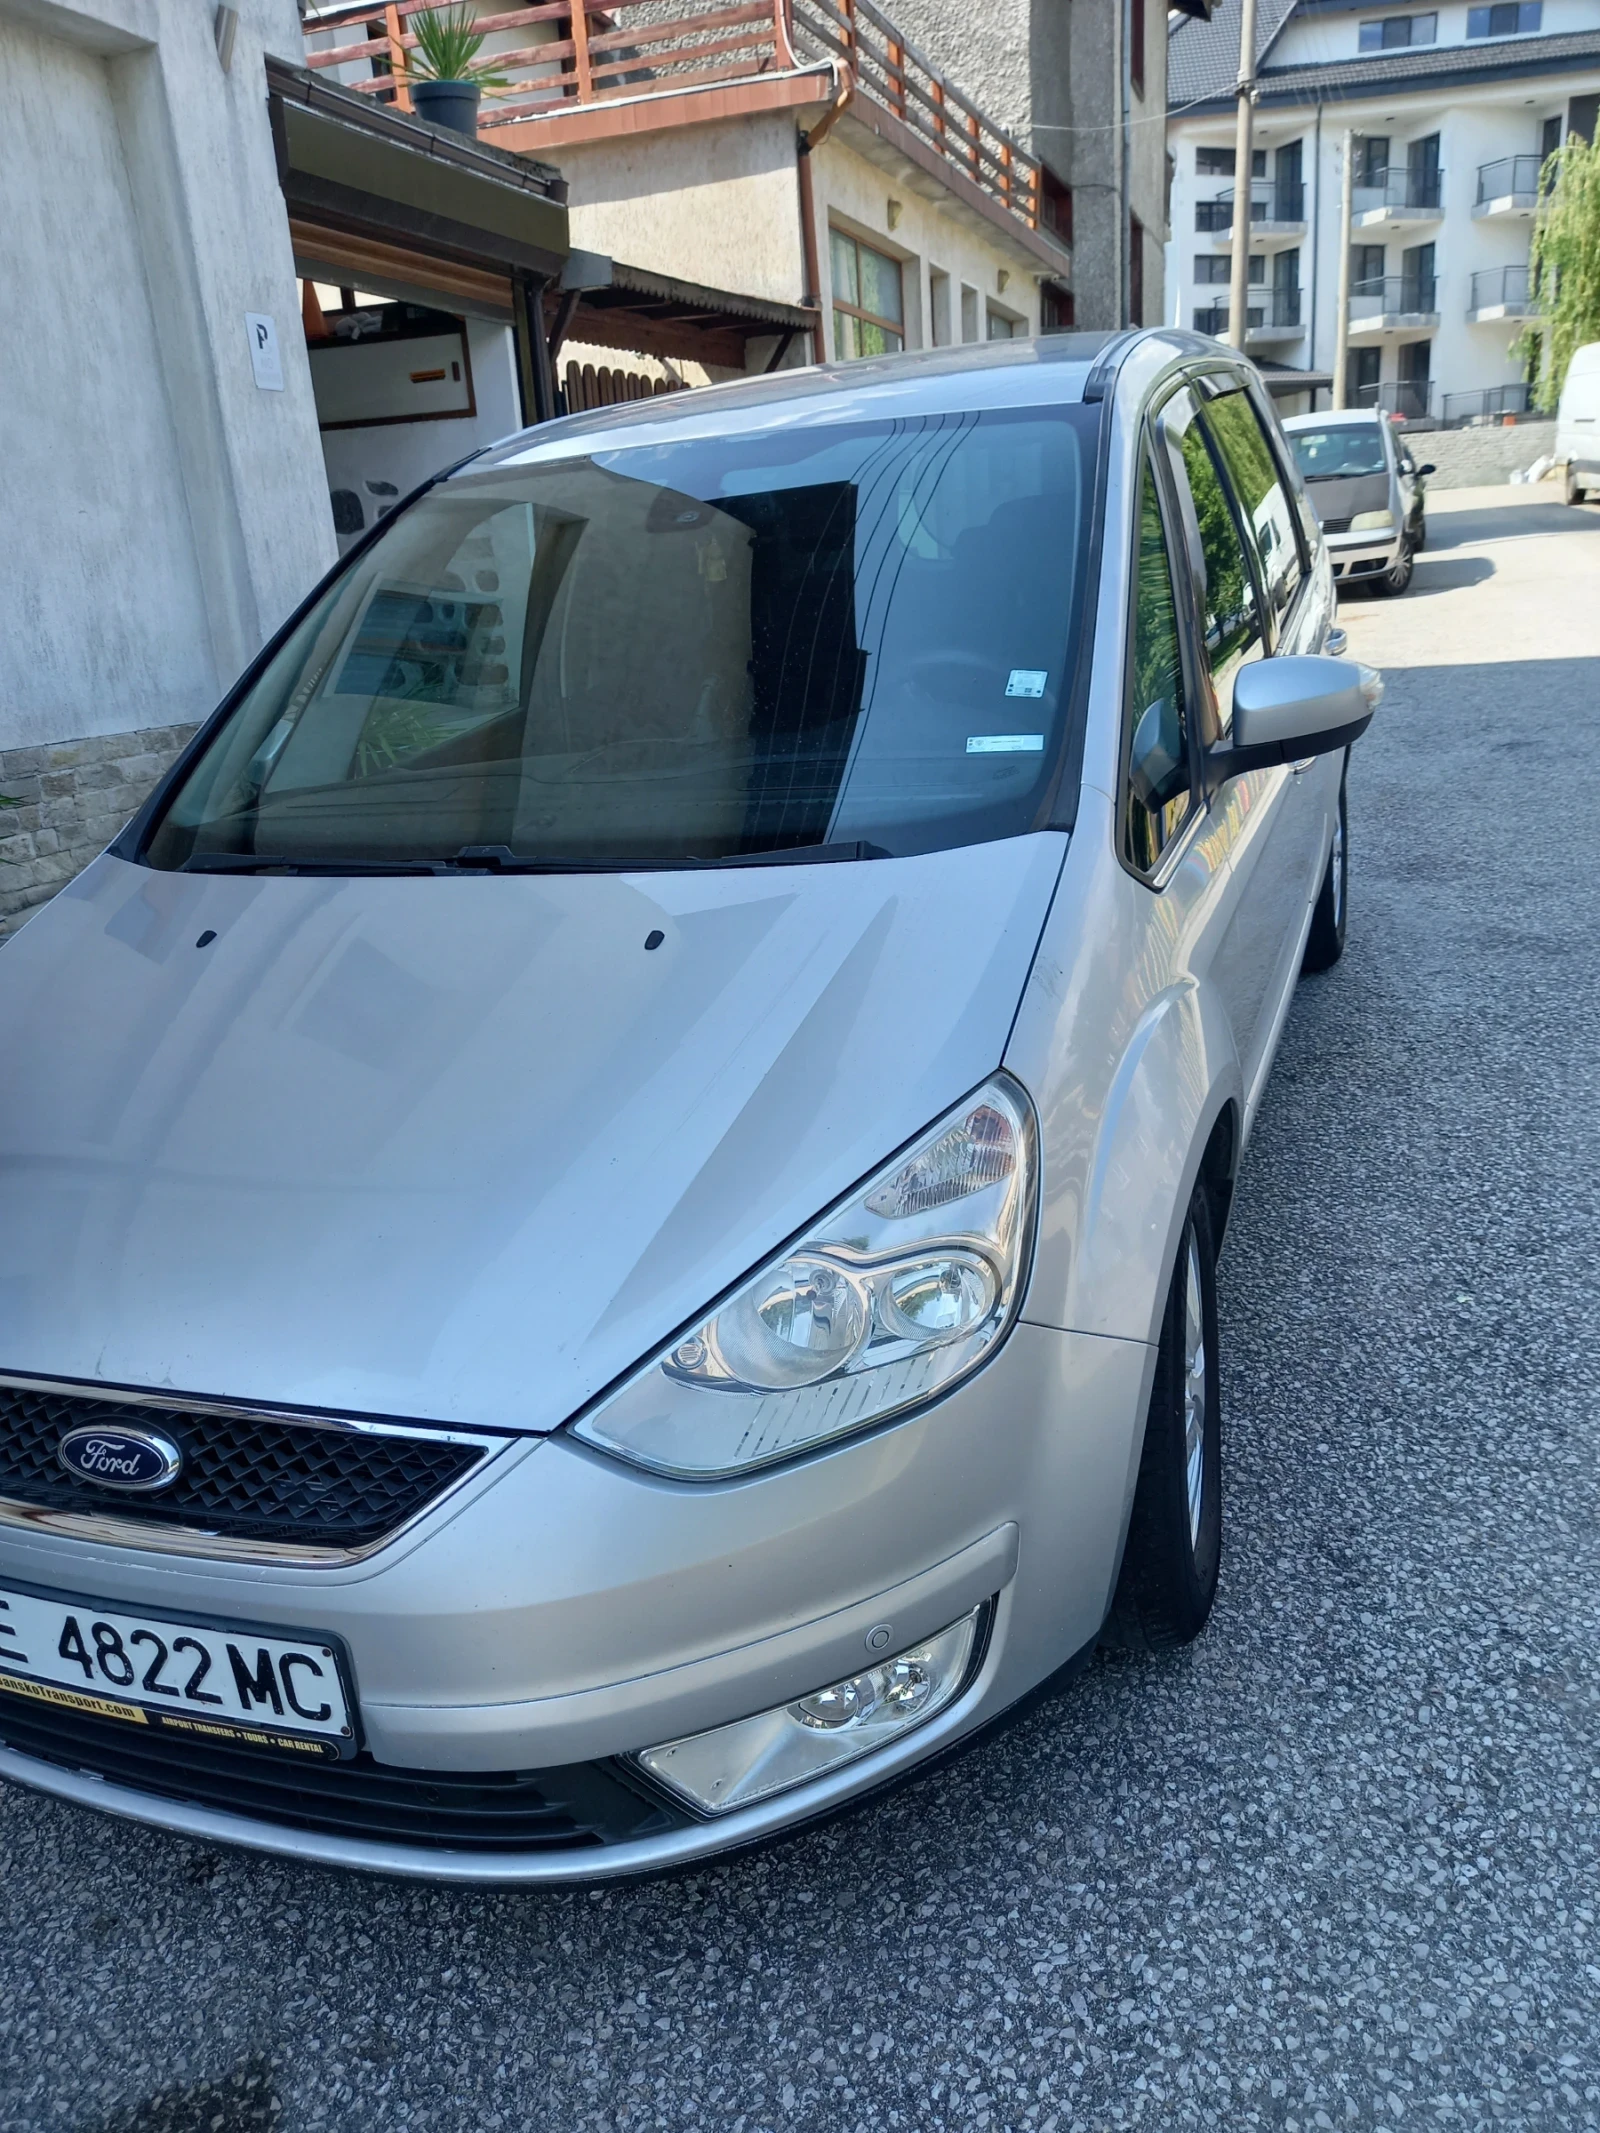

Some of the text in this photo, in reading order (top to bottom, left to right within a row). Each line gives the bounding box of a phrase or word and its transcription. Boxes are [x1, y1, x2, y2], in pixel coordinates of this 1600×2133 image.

[256, 323, 268, 349] P
[80, 1439, 141, 1475] Ford
[58, 1615, 224, 1705] 4822
[226, 1643, 332, 1721] MC
[162, 1716, 323, 1753] AIRPORT TRANSFERS TOURS CAR RENTAL
